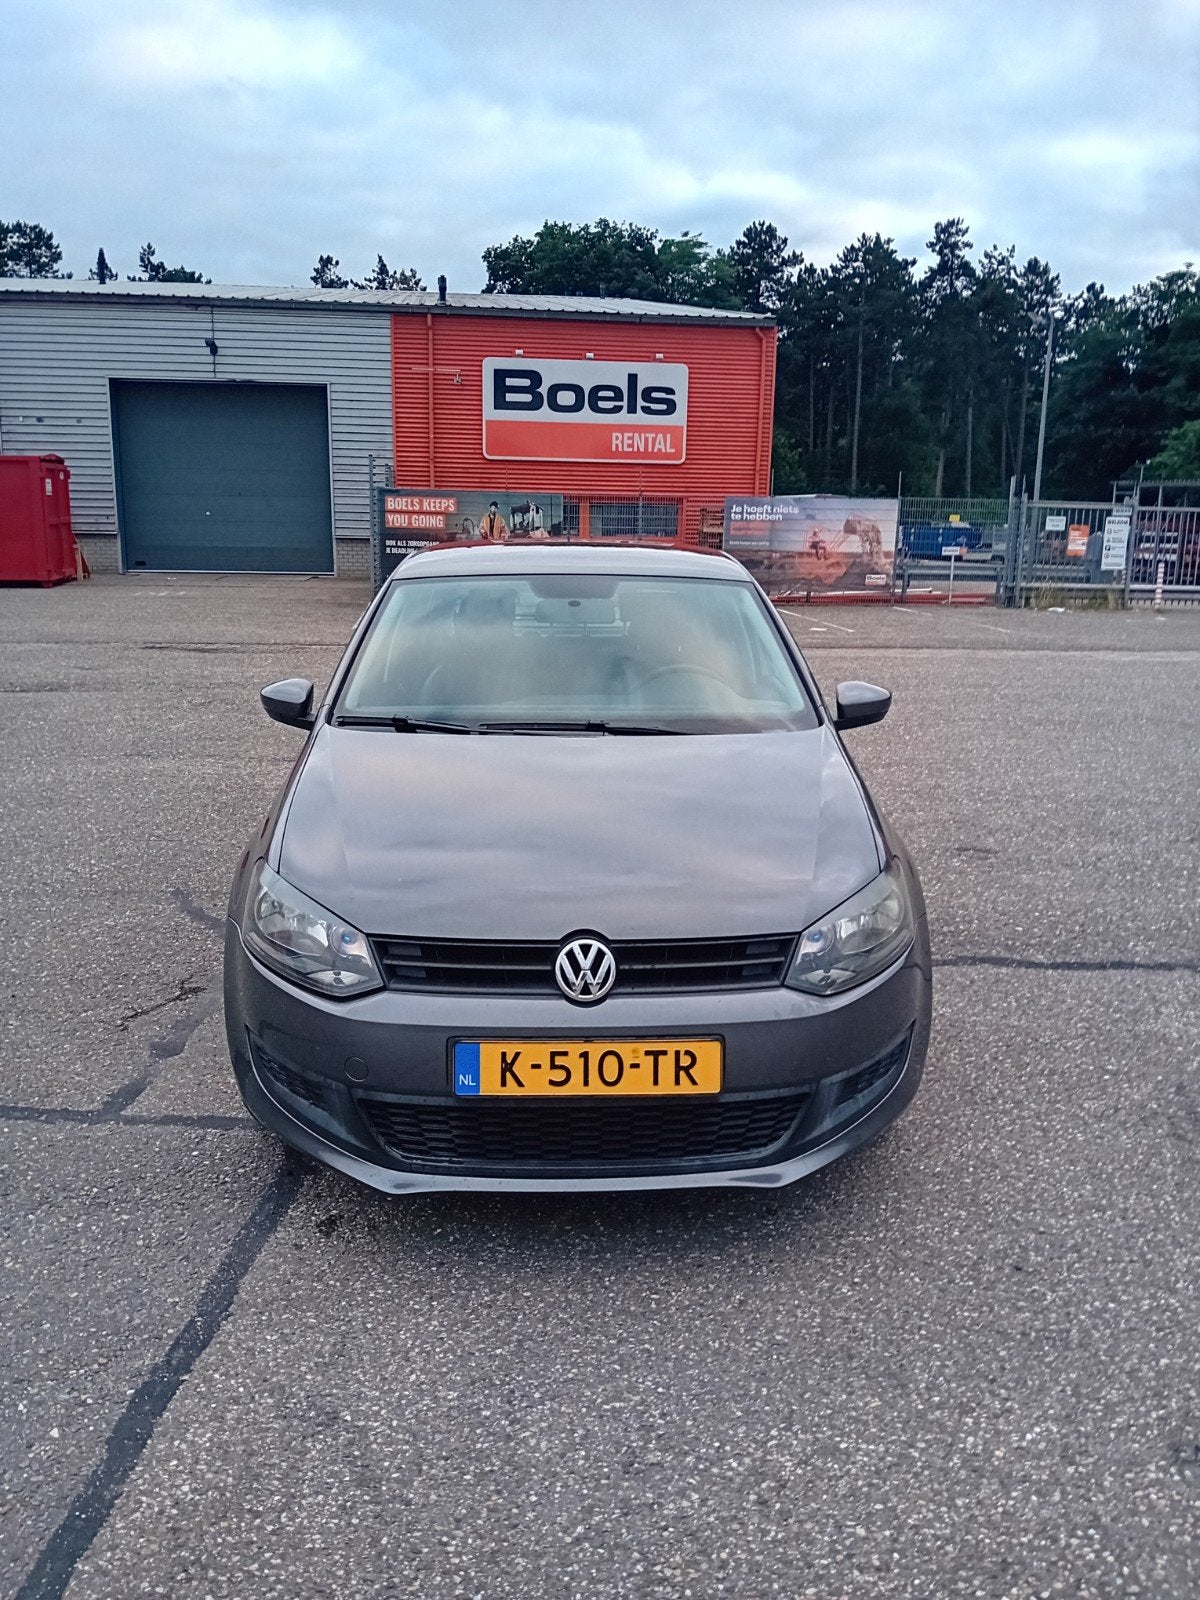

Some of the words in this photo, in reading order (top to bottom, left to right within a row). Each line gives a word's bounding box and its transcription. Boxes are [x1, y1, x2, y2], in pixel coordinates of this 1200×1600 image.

[493, 368, 677, 416] Boels
[611, 432, 675, 453] RENTAL
[387, 497, 420, 511] BOELS
[423, 498, 455, 512] KEEPS
[731, 504, 742, 513] Je
[743, 504, 771, 513] hoeft
[773, 505, 799, 514] niets
[387, 514, 408, 527] YOU
[411, 515, 443, 528] GOING
[743, 512, 783, 520] hebben
[459, 1074, 476, 1086] NL
[500, 1049, 699, 1088] K-510-TR
